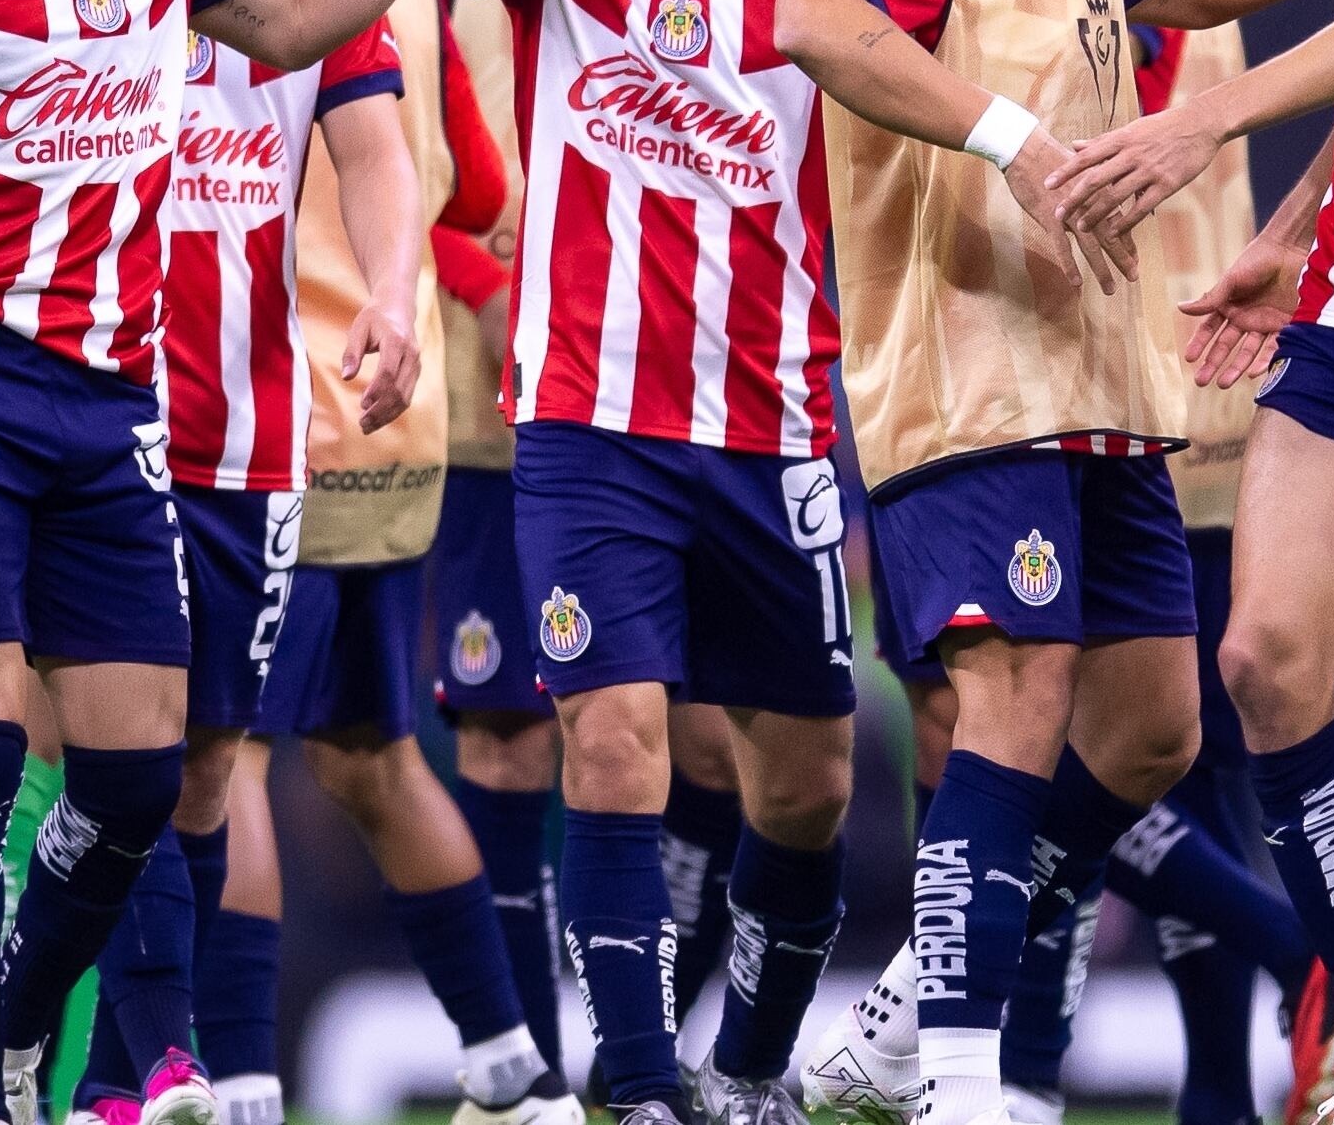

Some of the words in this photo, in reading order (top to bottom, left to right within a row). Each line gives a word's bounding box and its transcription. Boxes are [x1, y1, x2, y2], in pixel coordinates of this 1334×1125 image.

[567, 50, 775, 154] Caliente
[586, 118, 776, 192] caliente.mx
[913, 838, 973, 1001] PERDURA
